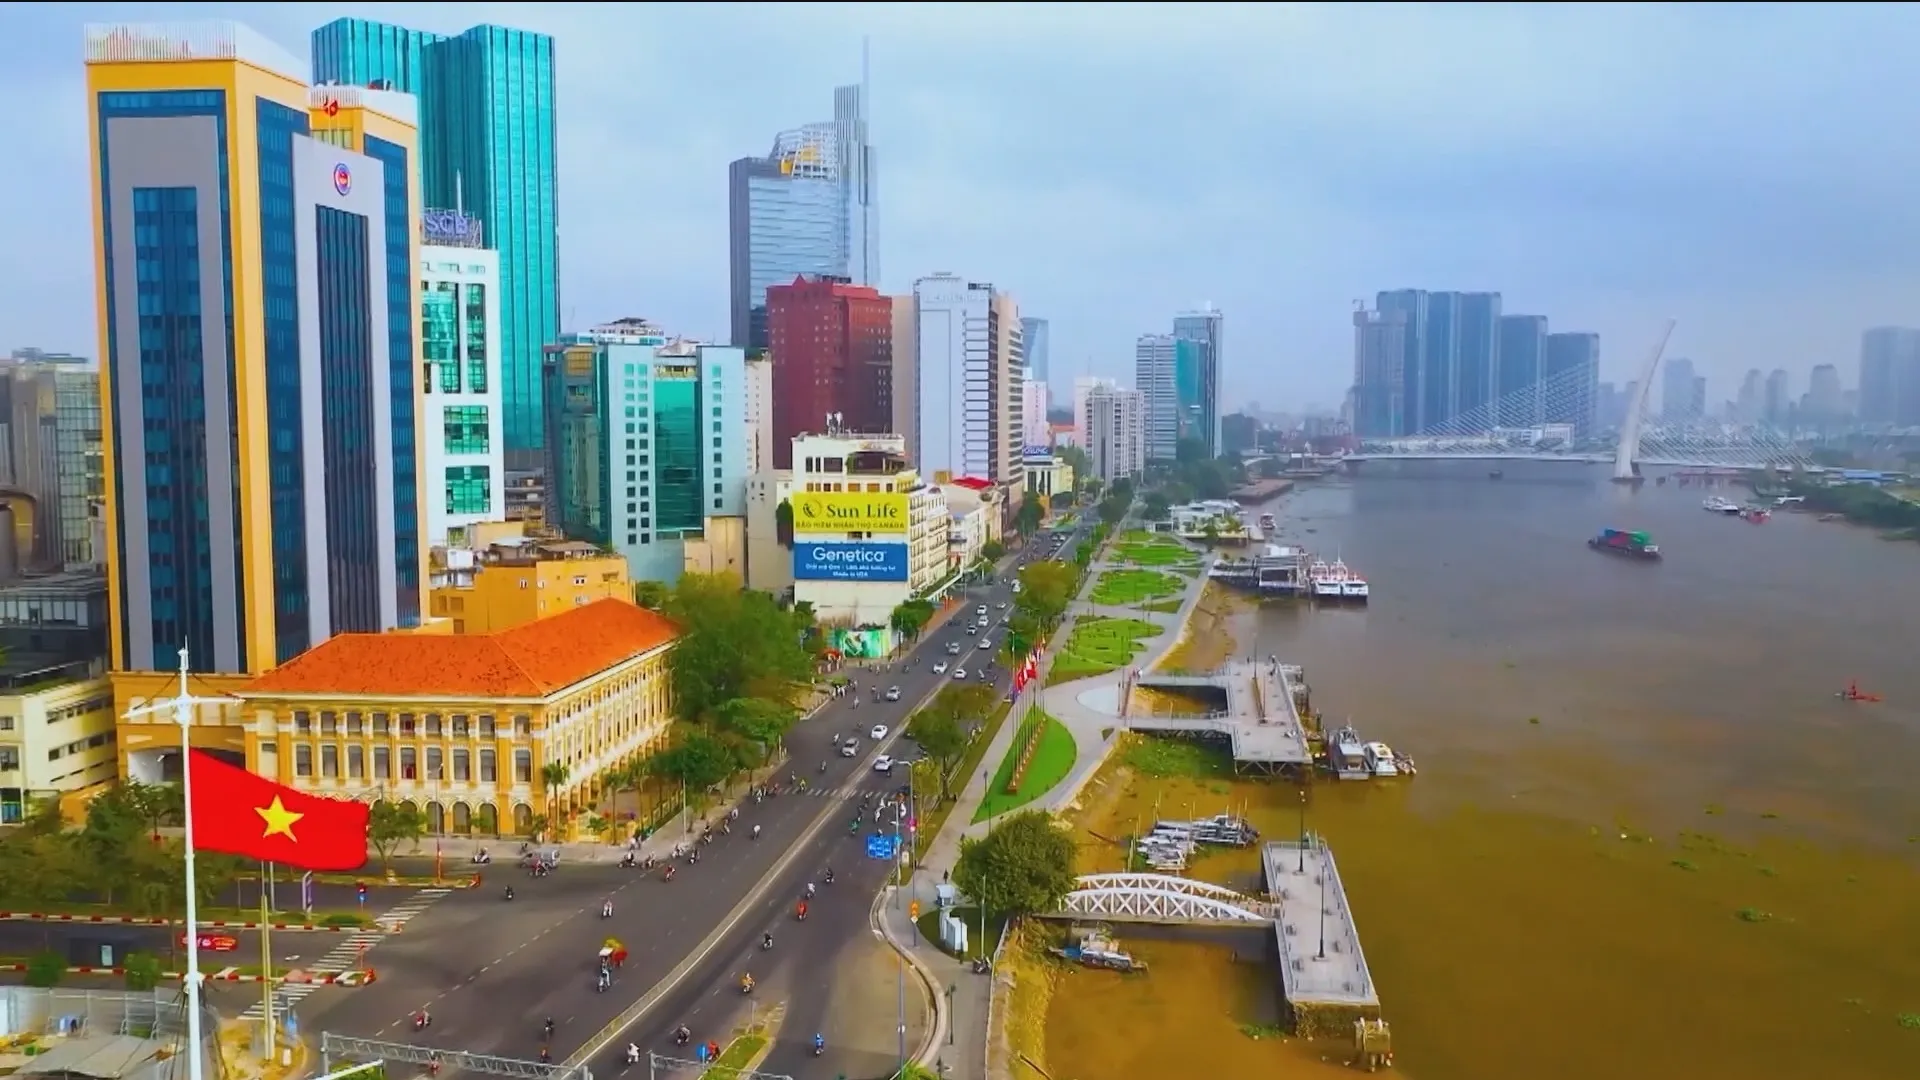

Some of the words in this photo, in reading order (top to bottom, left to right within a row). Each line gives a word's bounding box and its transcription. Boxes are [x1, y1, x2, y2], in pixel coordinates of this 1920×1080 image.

[826, 503, 859, 518] Sun
[867, 502, 898, 518] Life
[873, 521, 904, 529] CANADA
[812, 547, 885, 562] Genetica
